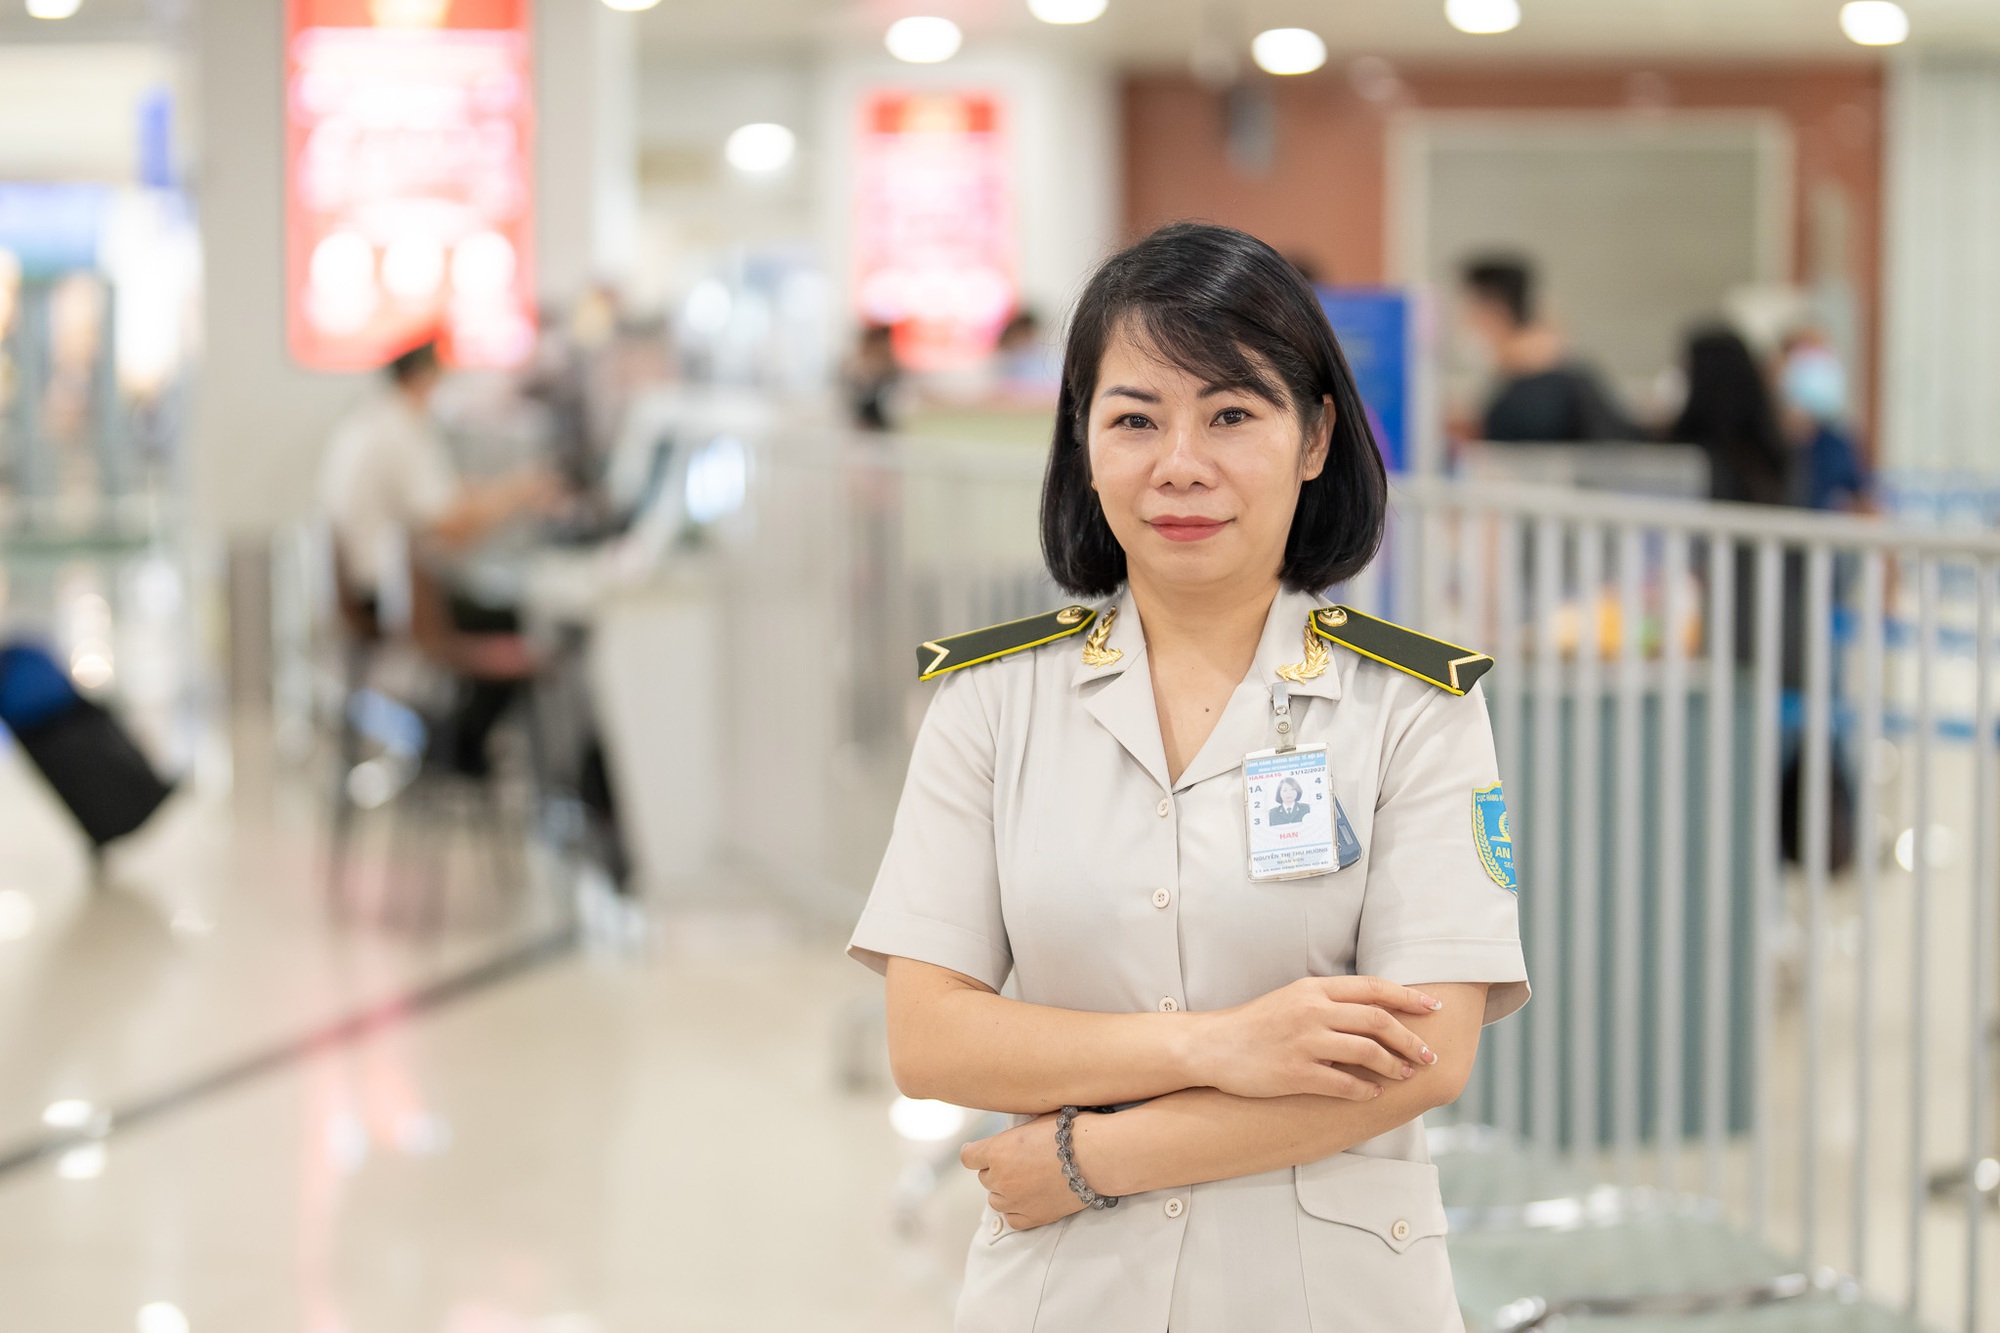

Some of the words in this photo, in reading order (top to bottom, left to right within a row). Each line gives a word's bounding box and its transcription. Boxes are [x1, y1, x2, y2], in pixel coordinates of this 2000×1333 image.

[1290, 767, 1326, 776] 31/12/2022
[1249, 785, 1262, 794] 1A
[1254, 801, 1261, 809] 2
[1280, 831, 1299, 840] HAN
[1495, 846, 1511, 859] AN
